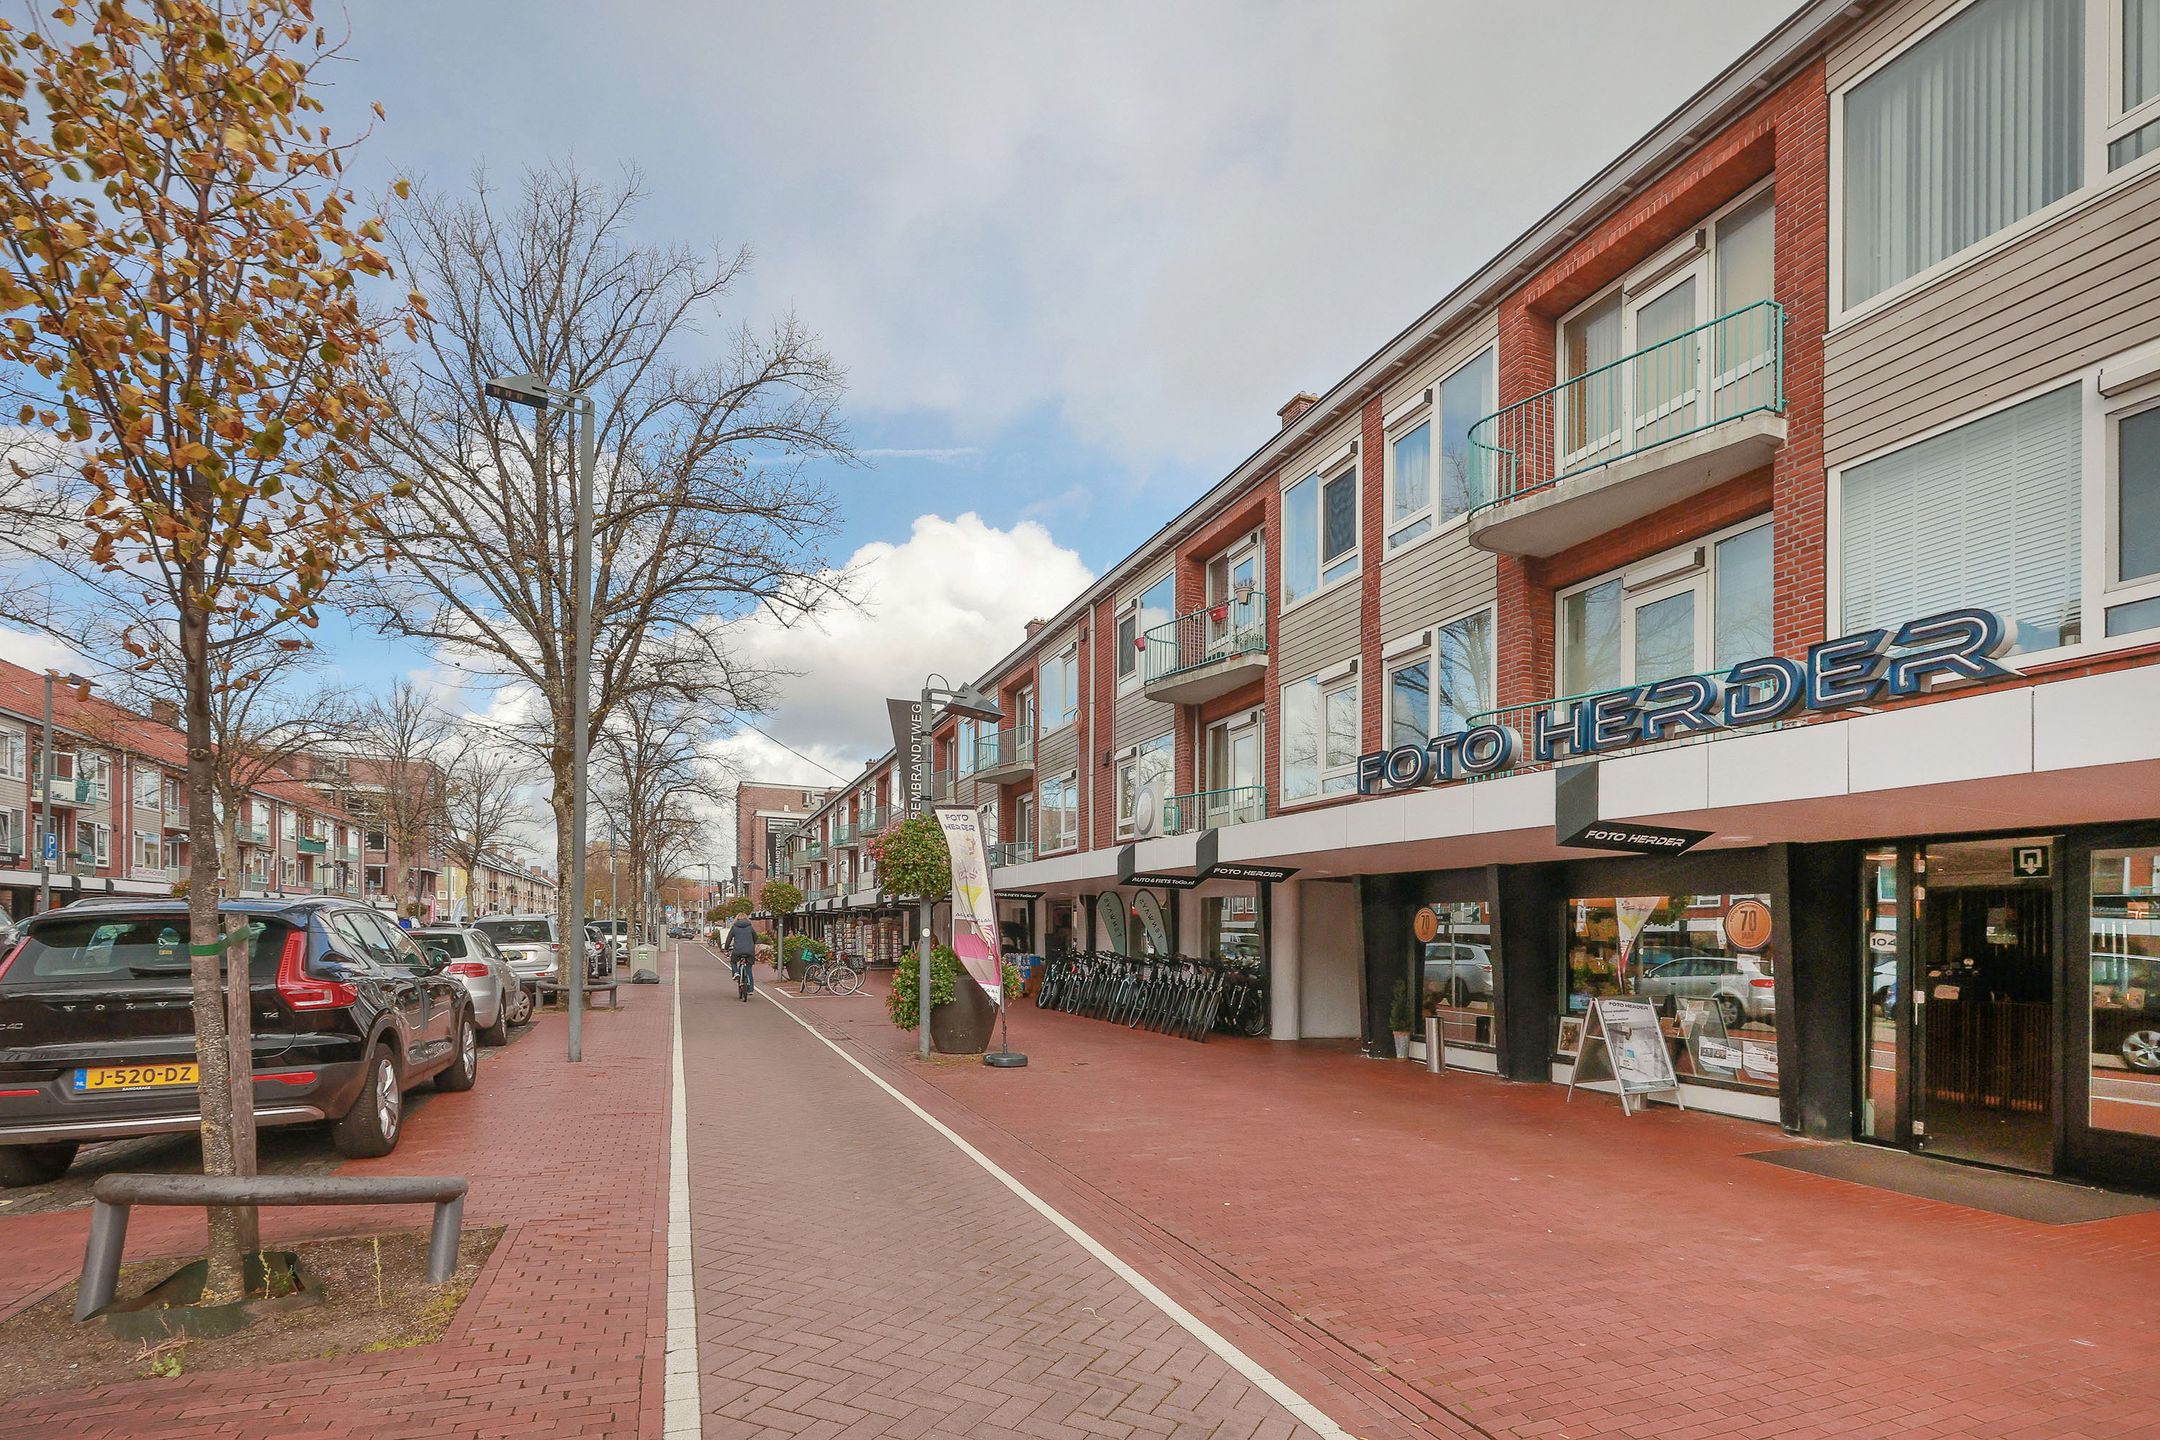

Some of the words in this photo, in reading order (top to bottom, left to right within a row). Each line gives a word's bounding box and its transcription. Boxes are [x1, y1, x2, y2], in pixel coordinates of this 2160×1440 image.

[1357, 726, 1521, 795] FOTO
[1536, 608, 2026, 762] HERDER
[910, 703, 922, 820] REMBRANDTWEG
[944, 813, 969, 822] FOTO
[48, 835, 55, 849] P
[1584, 830, 1627, 842] FOTO
[1627, 834, 1686, 847] HERDER
[1213, 867, 1242, 876] FOTO
[1242, 869, 1285, 879] HERDER
[1421, 914, 1430, 930] 70
[1740, 910, 1757, 931] 70
[1624, 1003, 1649, 1011] HERDER
[262, 1011, 279, 1019] T4
[0, 1022, 24, 1031] C40
[93, 1066, 192, 1087] J-520-DZ
[75, 1081, 86, 1089] NL
